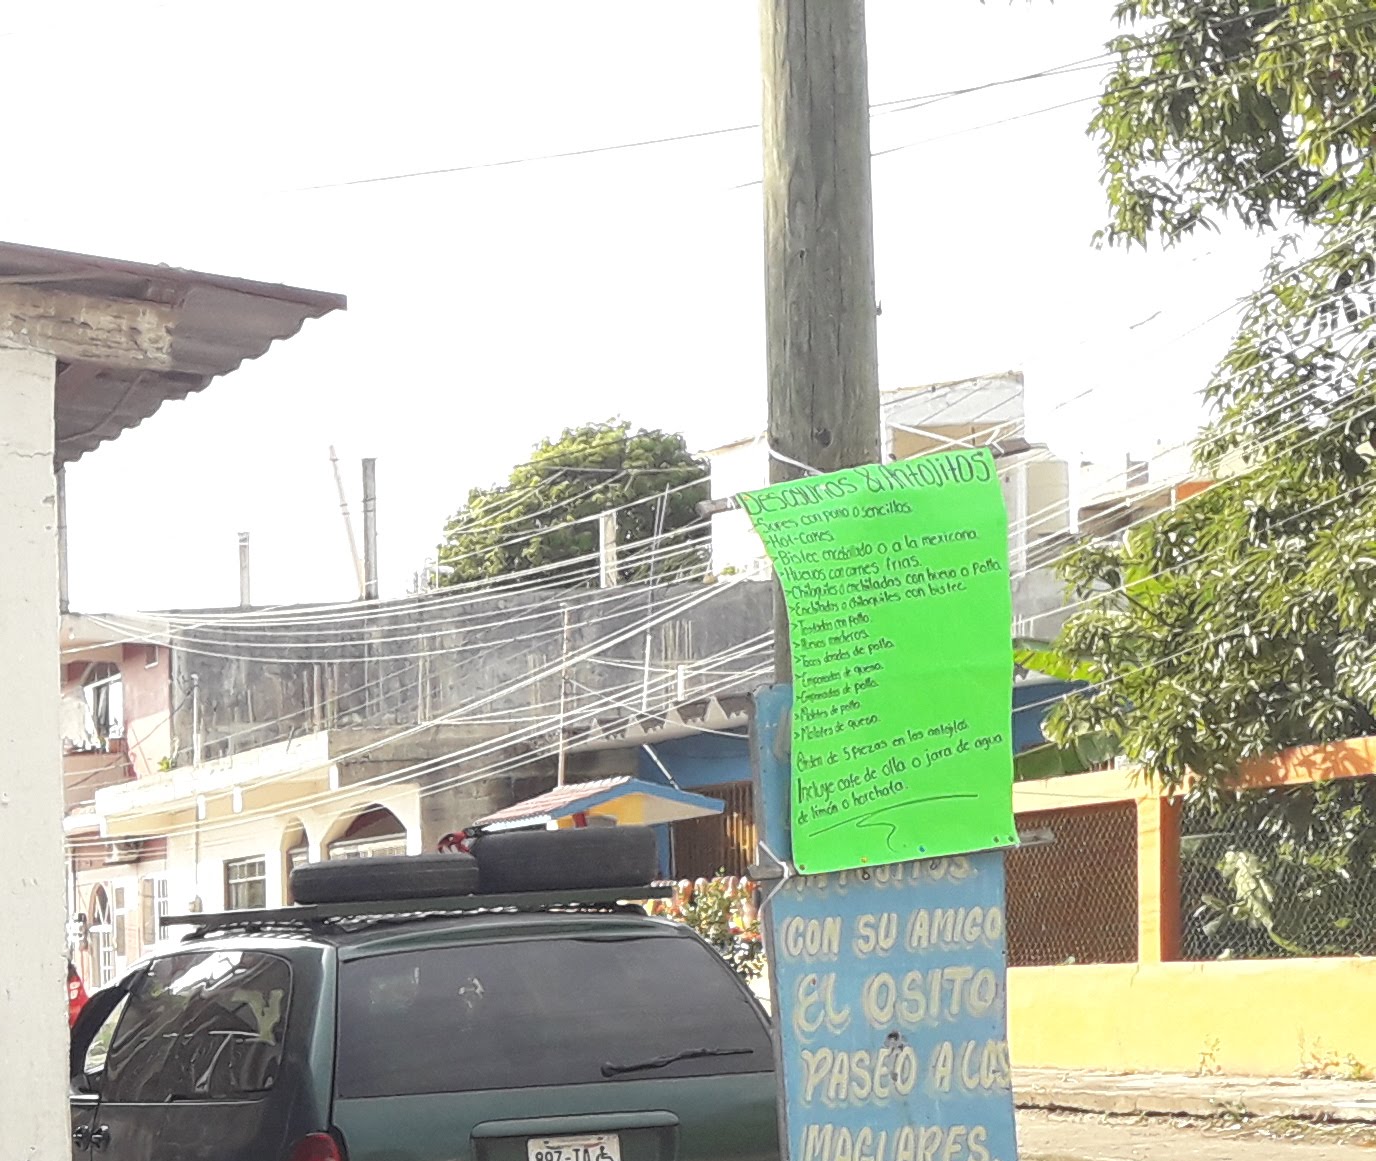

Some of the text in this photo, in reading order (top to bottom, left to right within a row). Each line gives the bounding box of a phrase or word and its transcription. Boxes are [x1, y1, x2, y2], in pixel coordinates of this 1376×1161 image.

[785, 906, 1002, 955] CON SU AMIGO
[795, 966, 997, 1034] EL OSITO
[801, 1046, 918, 1101] PASEO
